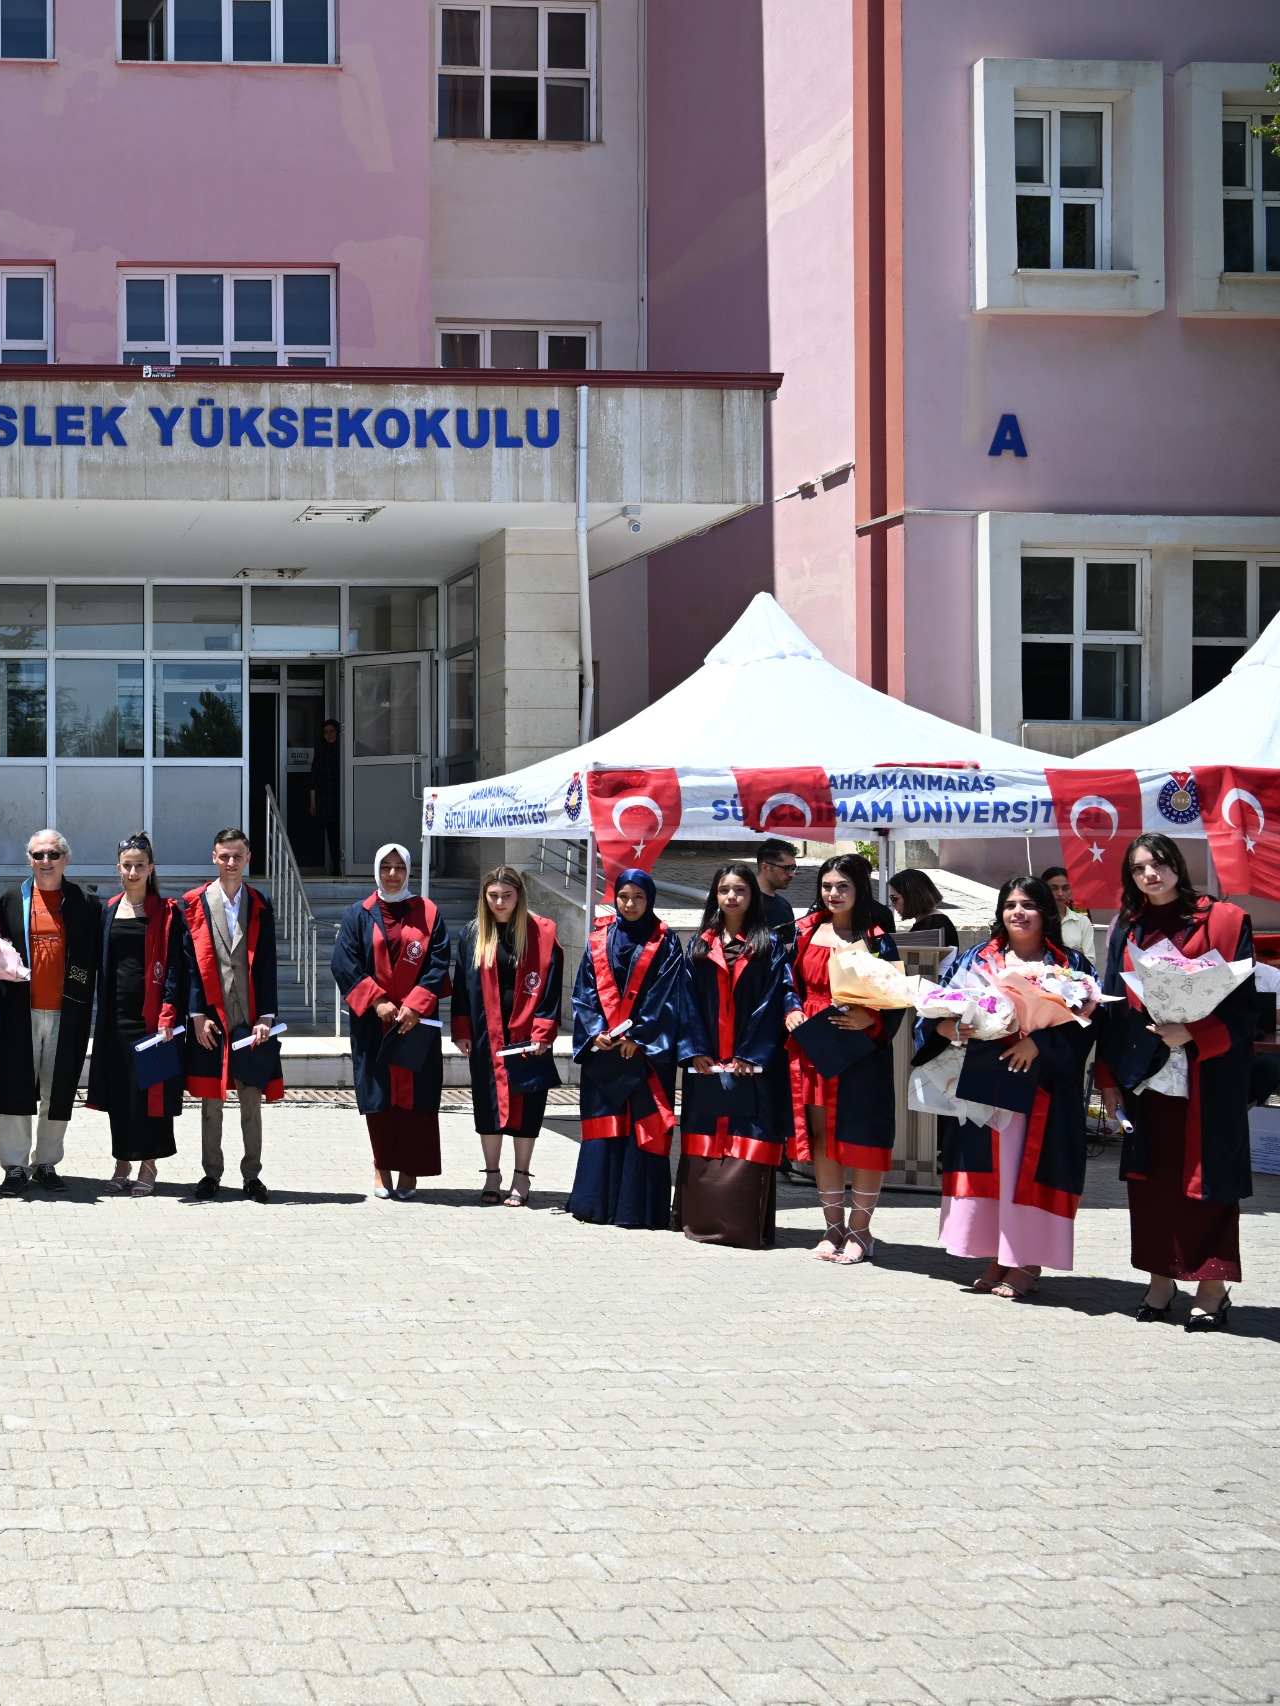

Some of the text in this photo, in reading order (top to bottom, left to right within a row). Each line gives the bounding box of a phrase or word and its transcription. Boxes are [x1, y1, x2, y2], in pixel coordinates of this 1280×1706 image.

[149, 398, 561, 449] YÜKSEKOKULU
[988, 414, 1028, 457] A
[467, 804, 487, 828] İMAM
[488, 797, 548, 828] ÜNİVERSİTESİ
